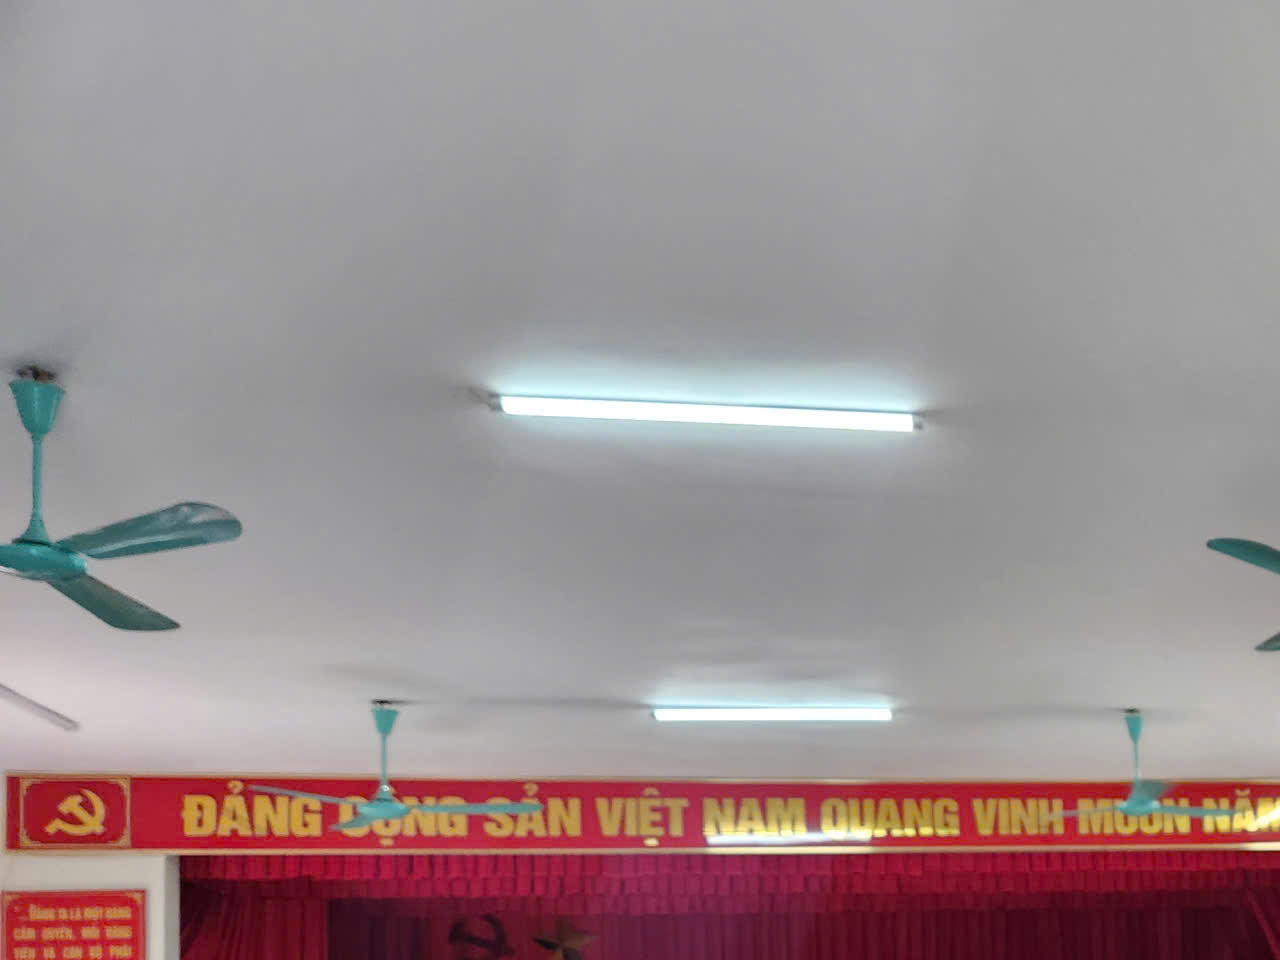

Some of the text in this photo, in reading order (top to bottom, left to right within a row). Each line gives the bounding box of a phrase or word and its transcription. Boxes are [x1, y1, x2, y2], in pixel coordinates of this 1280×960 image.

[182, 780, 322, 837] ĐẢNG
[483, 782, 582, 838] SẢN
[595, 786, 689, 847] VIỆT
[704, 797, 805, 836] NAM
[821, 797, 961, 837] QUANG
[975, 797, 1064, 836] VINH
